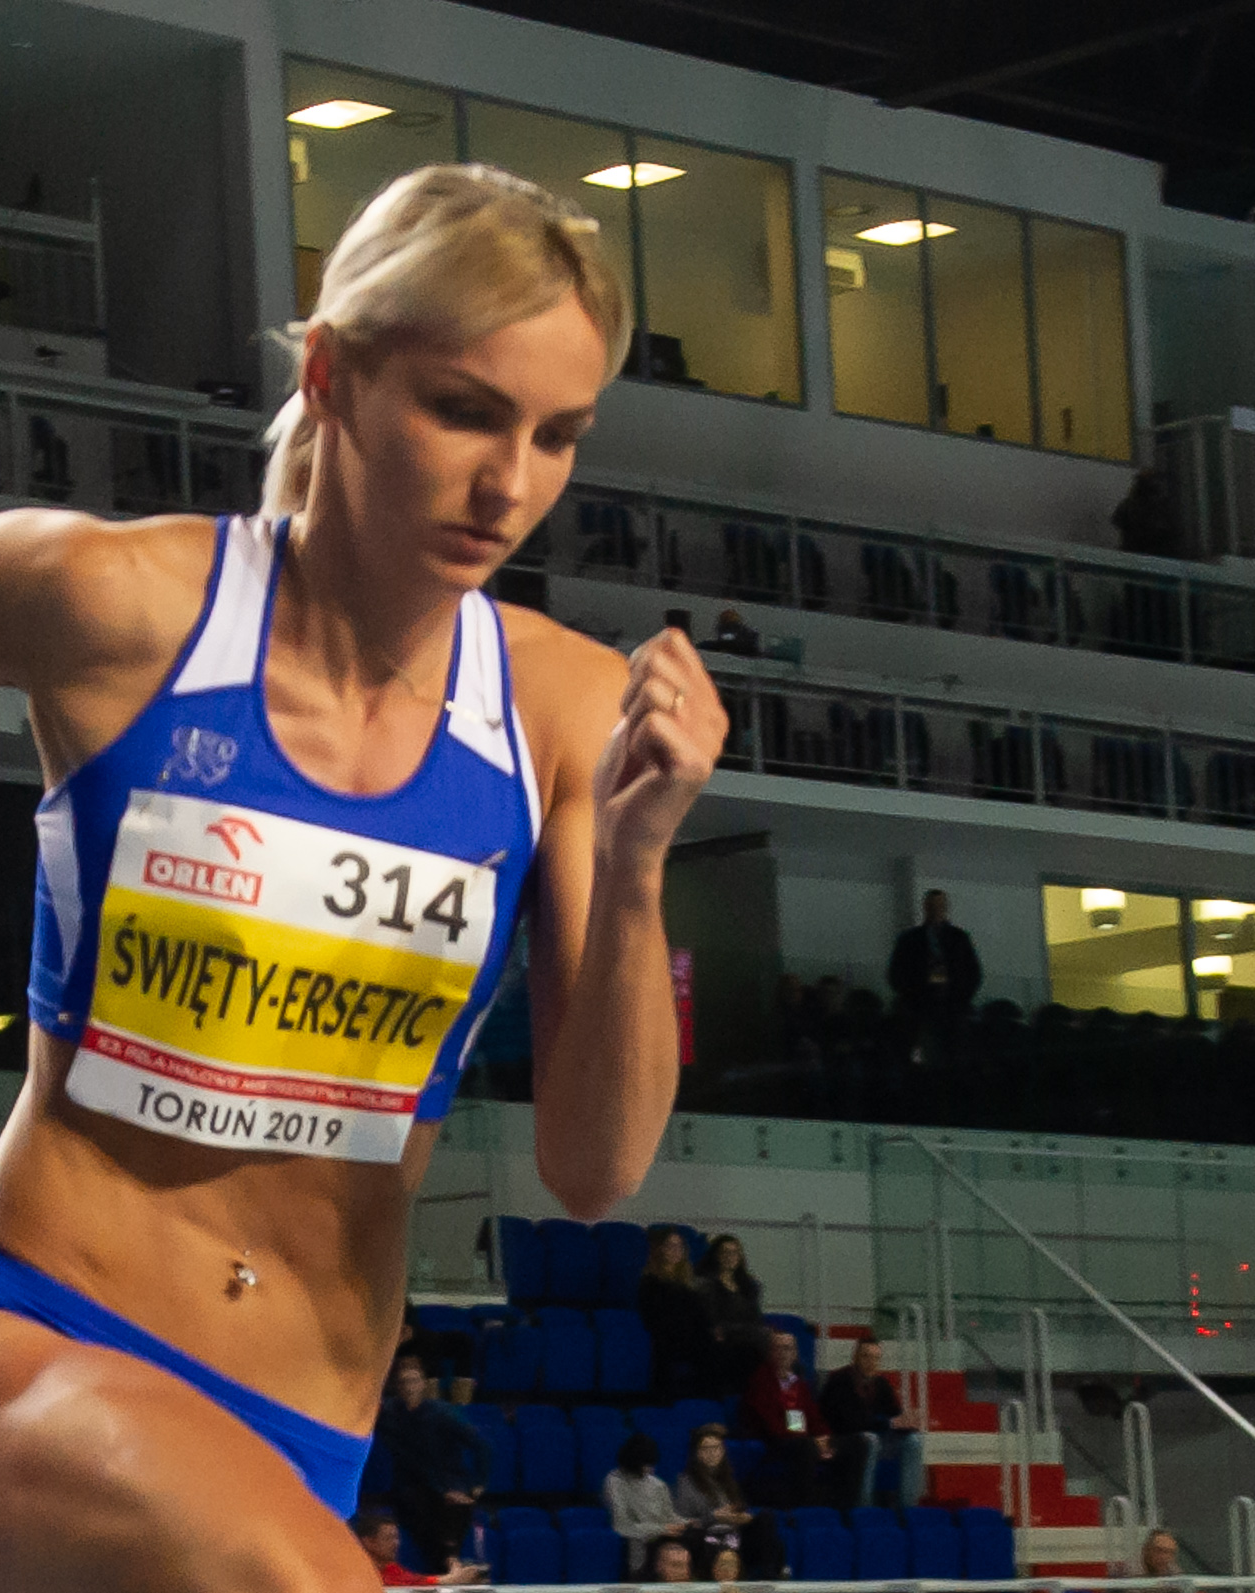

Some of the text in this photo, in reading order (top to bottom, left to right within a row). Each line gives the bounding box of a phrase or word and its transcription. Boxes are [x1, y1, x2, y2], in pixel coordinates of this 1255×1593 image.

[149, 858, 258, 904] ORLEN
[323, 851, 468, 943] 314
[111, 913, 447, 1048] ŚWIĘTY-ERSETIC
[138, 1082, 257, 1138] TORUŃ
[264, 1111, 343, 1146] 2019
